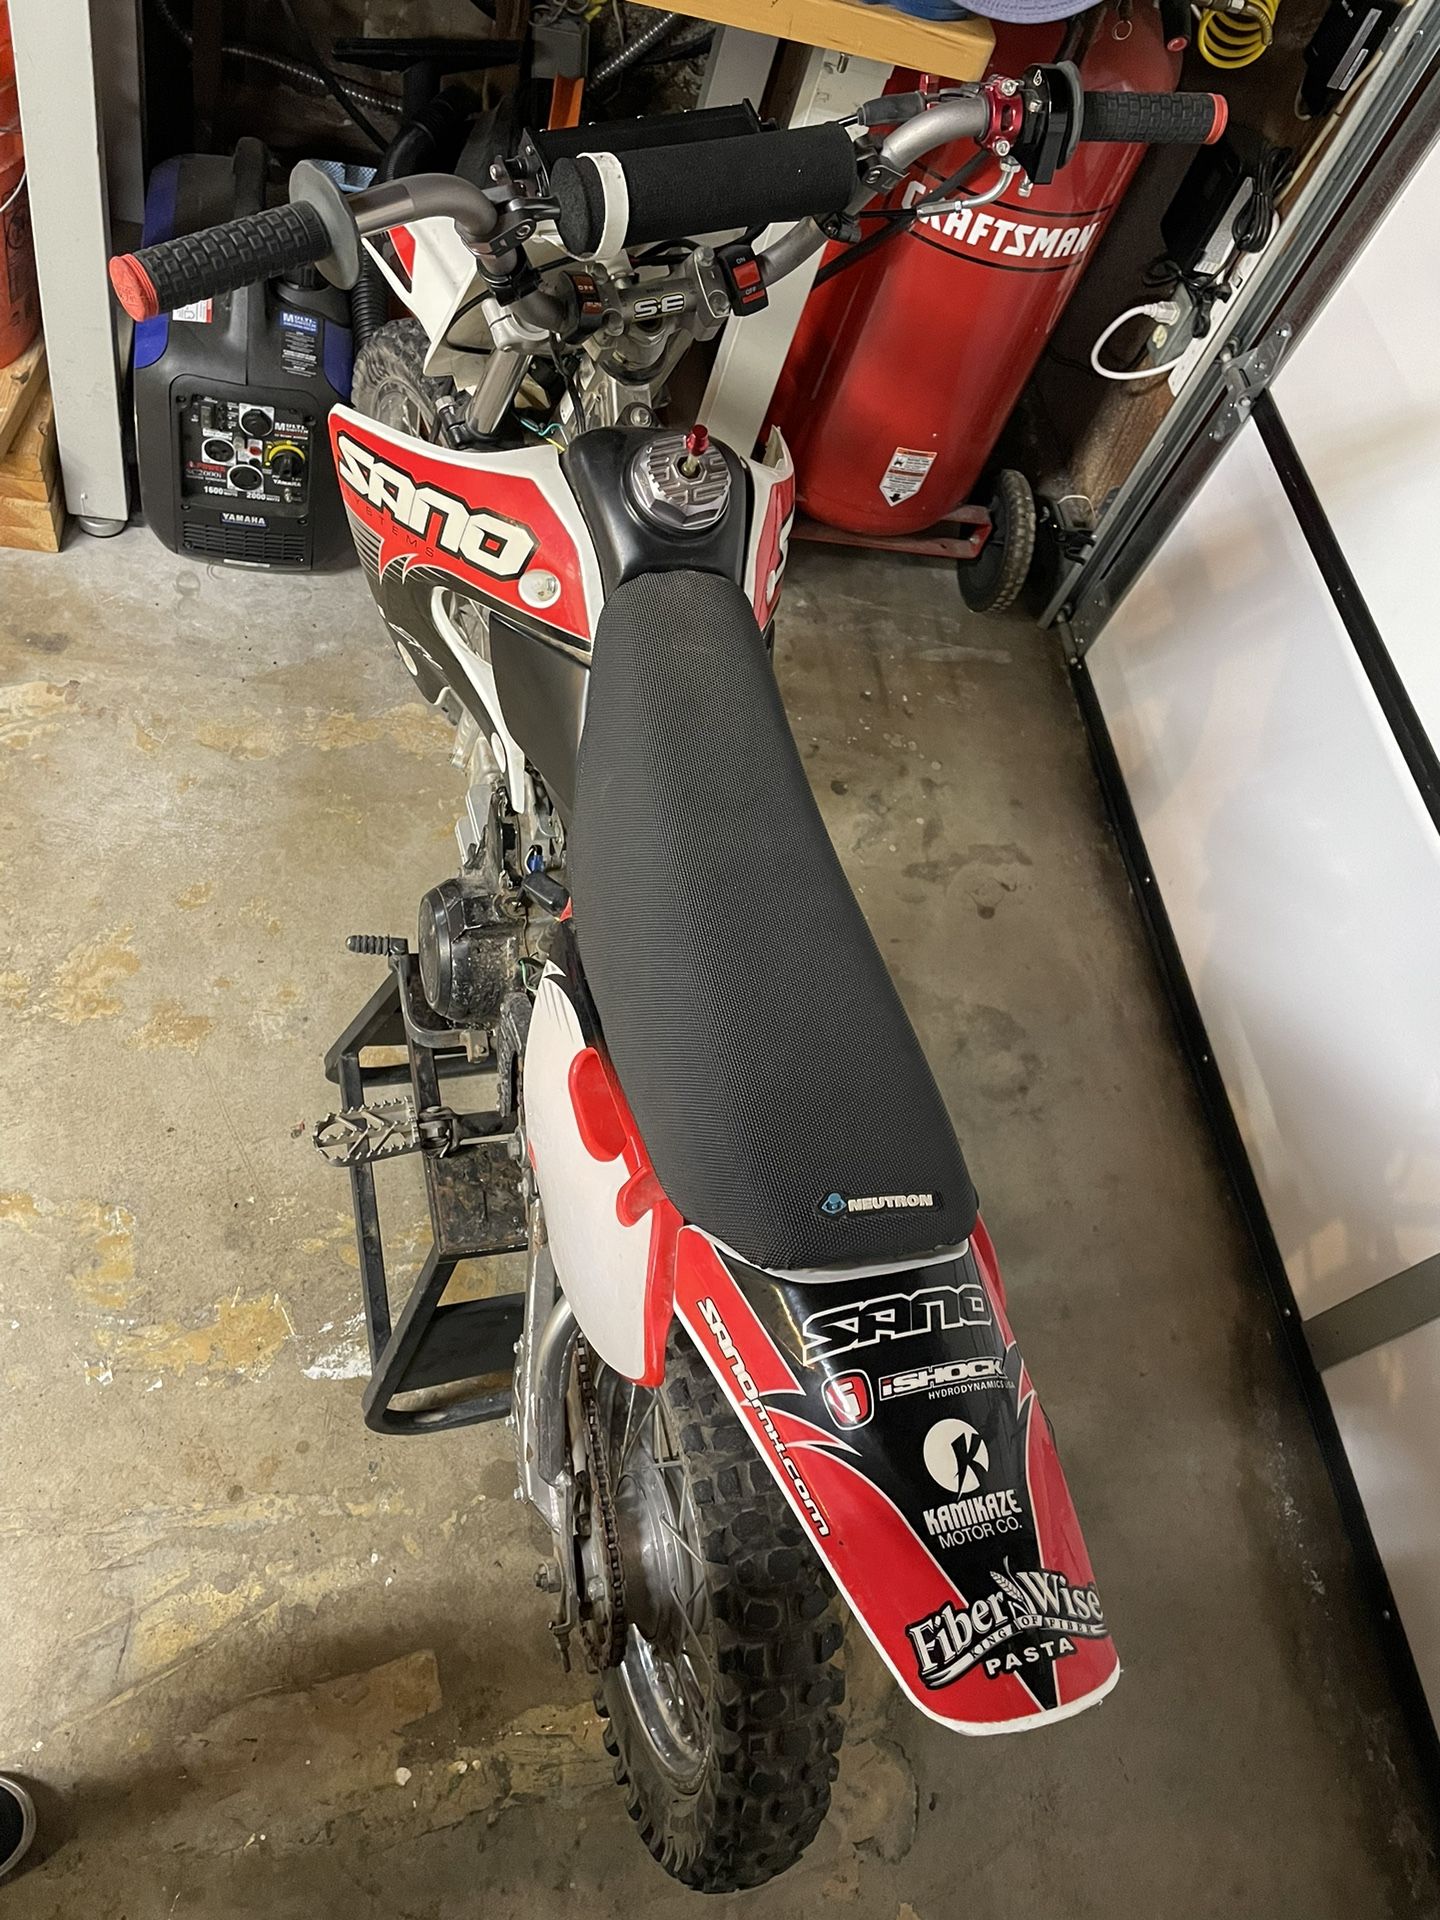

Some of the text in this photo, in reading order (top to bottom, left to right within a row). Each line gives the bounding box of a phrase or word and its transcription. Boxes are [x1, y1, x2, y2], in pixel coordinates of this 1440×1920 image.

[203, 486, 224, 495] 1600
[246, 492, 266, 500] 2000
[222, 513, 266, 525] YAMAHA
[847, 1194, 934, 1212] NEUTRON
[928, 1381, 1005, 1400] HYDRODYNAMICS
[923, 1489, 1022, 1536] KAMIKAZE
[938, 1516, 1023, 1549] MOTOR CO.
[909, 1571, 1104, 1675] Fiber Wise
[1022, 1616, 1039, 1626] OF
[1049, 1618, 1094, 1634] FIBER
[985, 1637, 1075, 1676] PASTA
